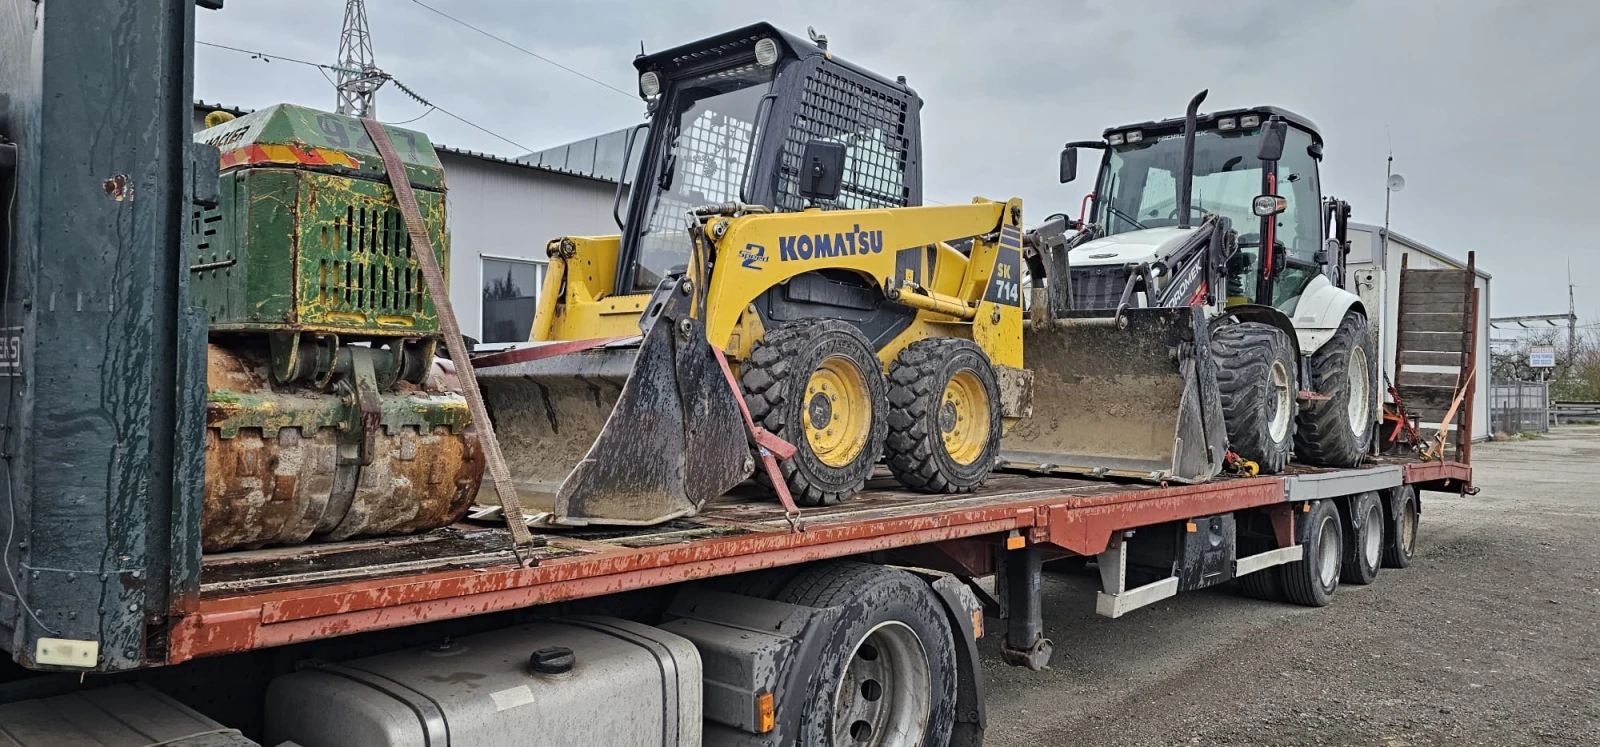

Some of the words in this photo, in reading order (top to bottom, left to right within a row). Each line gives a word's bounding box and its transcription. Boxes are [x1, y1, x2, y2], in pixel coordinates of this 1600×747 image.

[1157, 130, 1208, 142] HIDROEK
[778, 224, 883, 262] KOMATSU
[741, 243, 765, 270] 2
[997, 262, 1011, 279] SK
[1165, 258, 1203, 307] DROMEK
[995, 279, 1018, 302] 714
